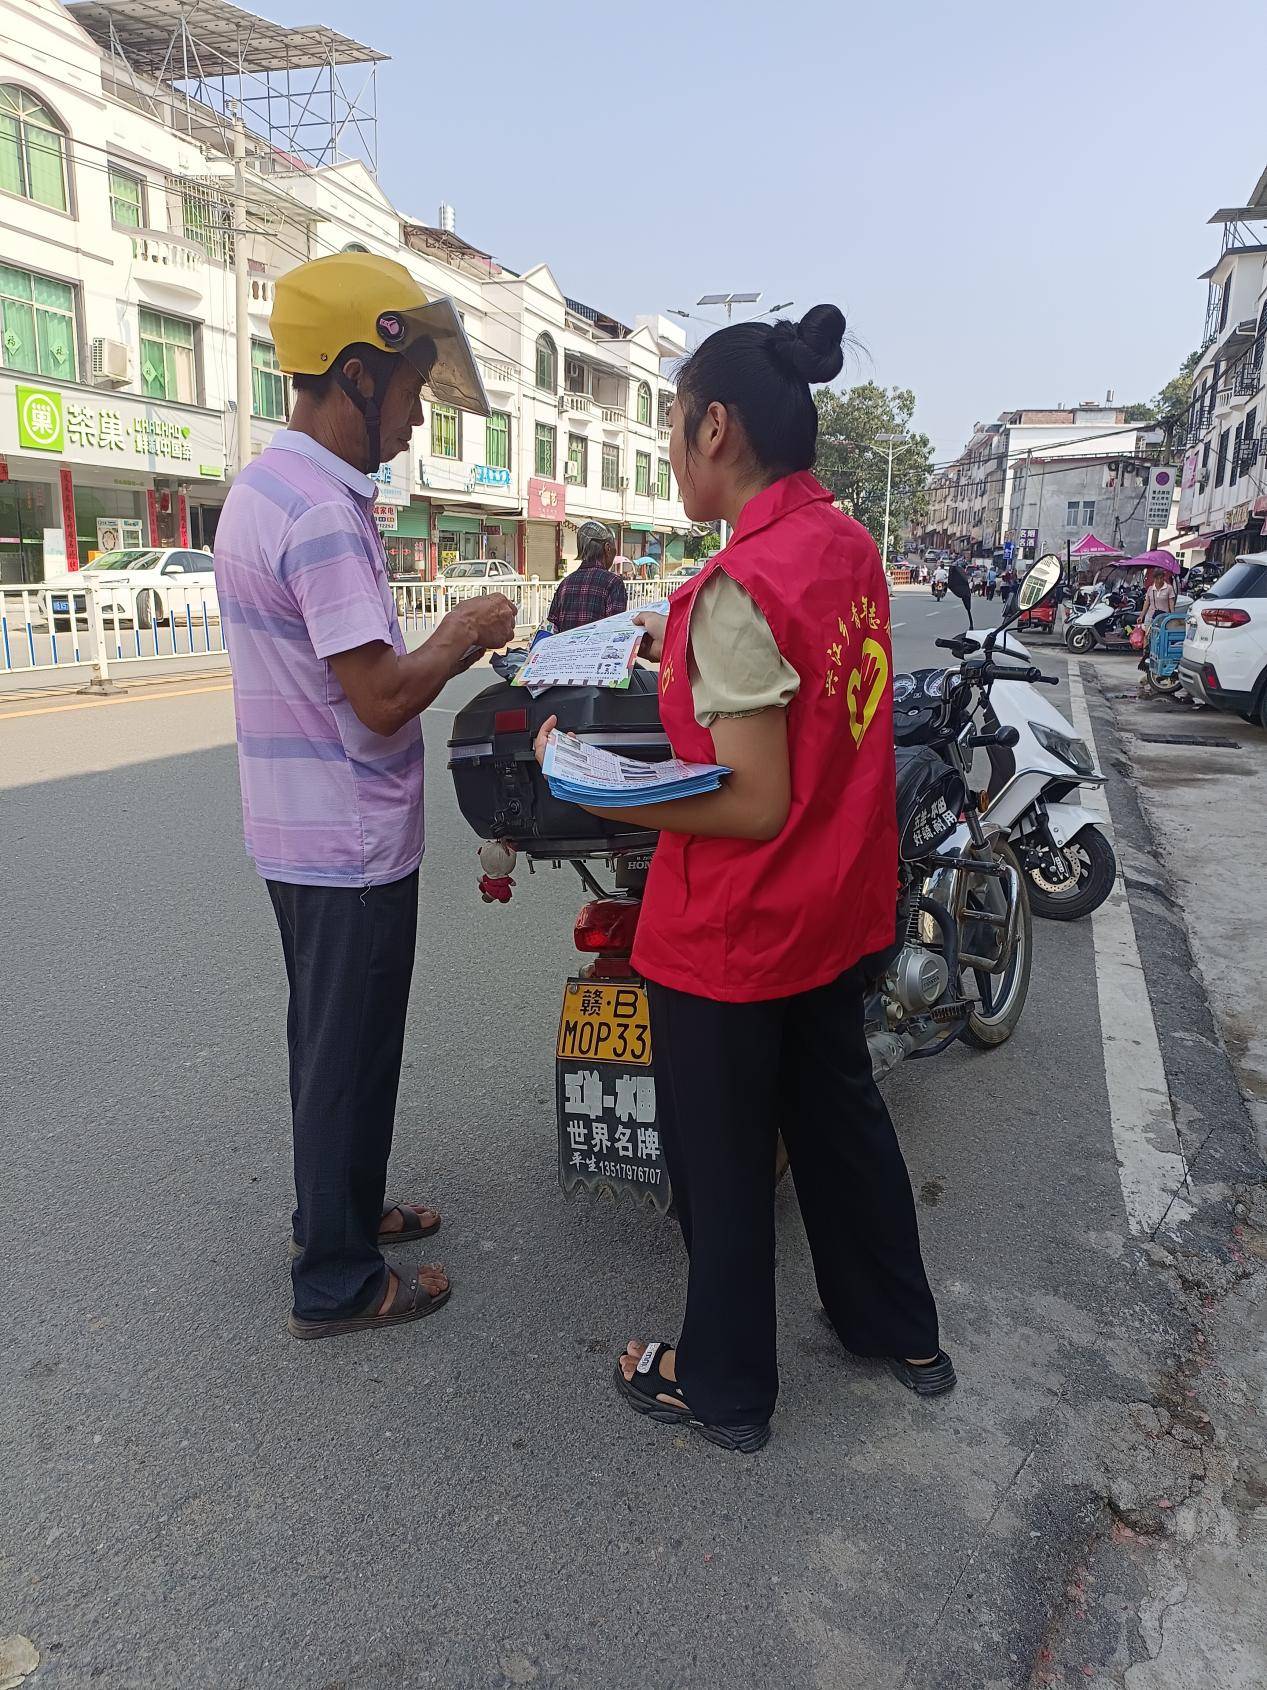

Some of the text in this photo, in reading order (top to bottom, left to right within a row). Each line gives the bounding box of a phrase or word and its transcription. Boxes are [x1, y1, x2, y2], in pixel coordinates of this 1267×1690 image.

[580, 988, 639, 1019] 赣·B
[567, 1120, 661, 1161] 世界名牌
[569, 1151, 662, 1185] 平生 13517976707
